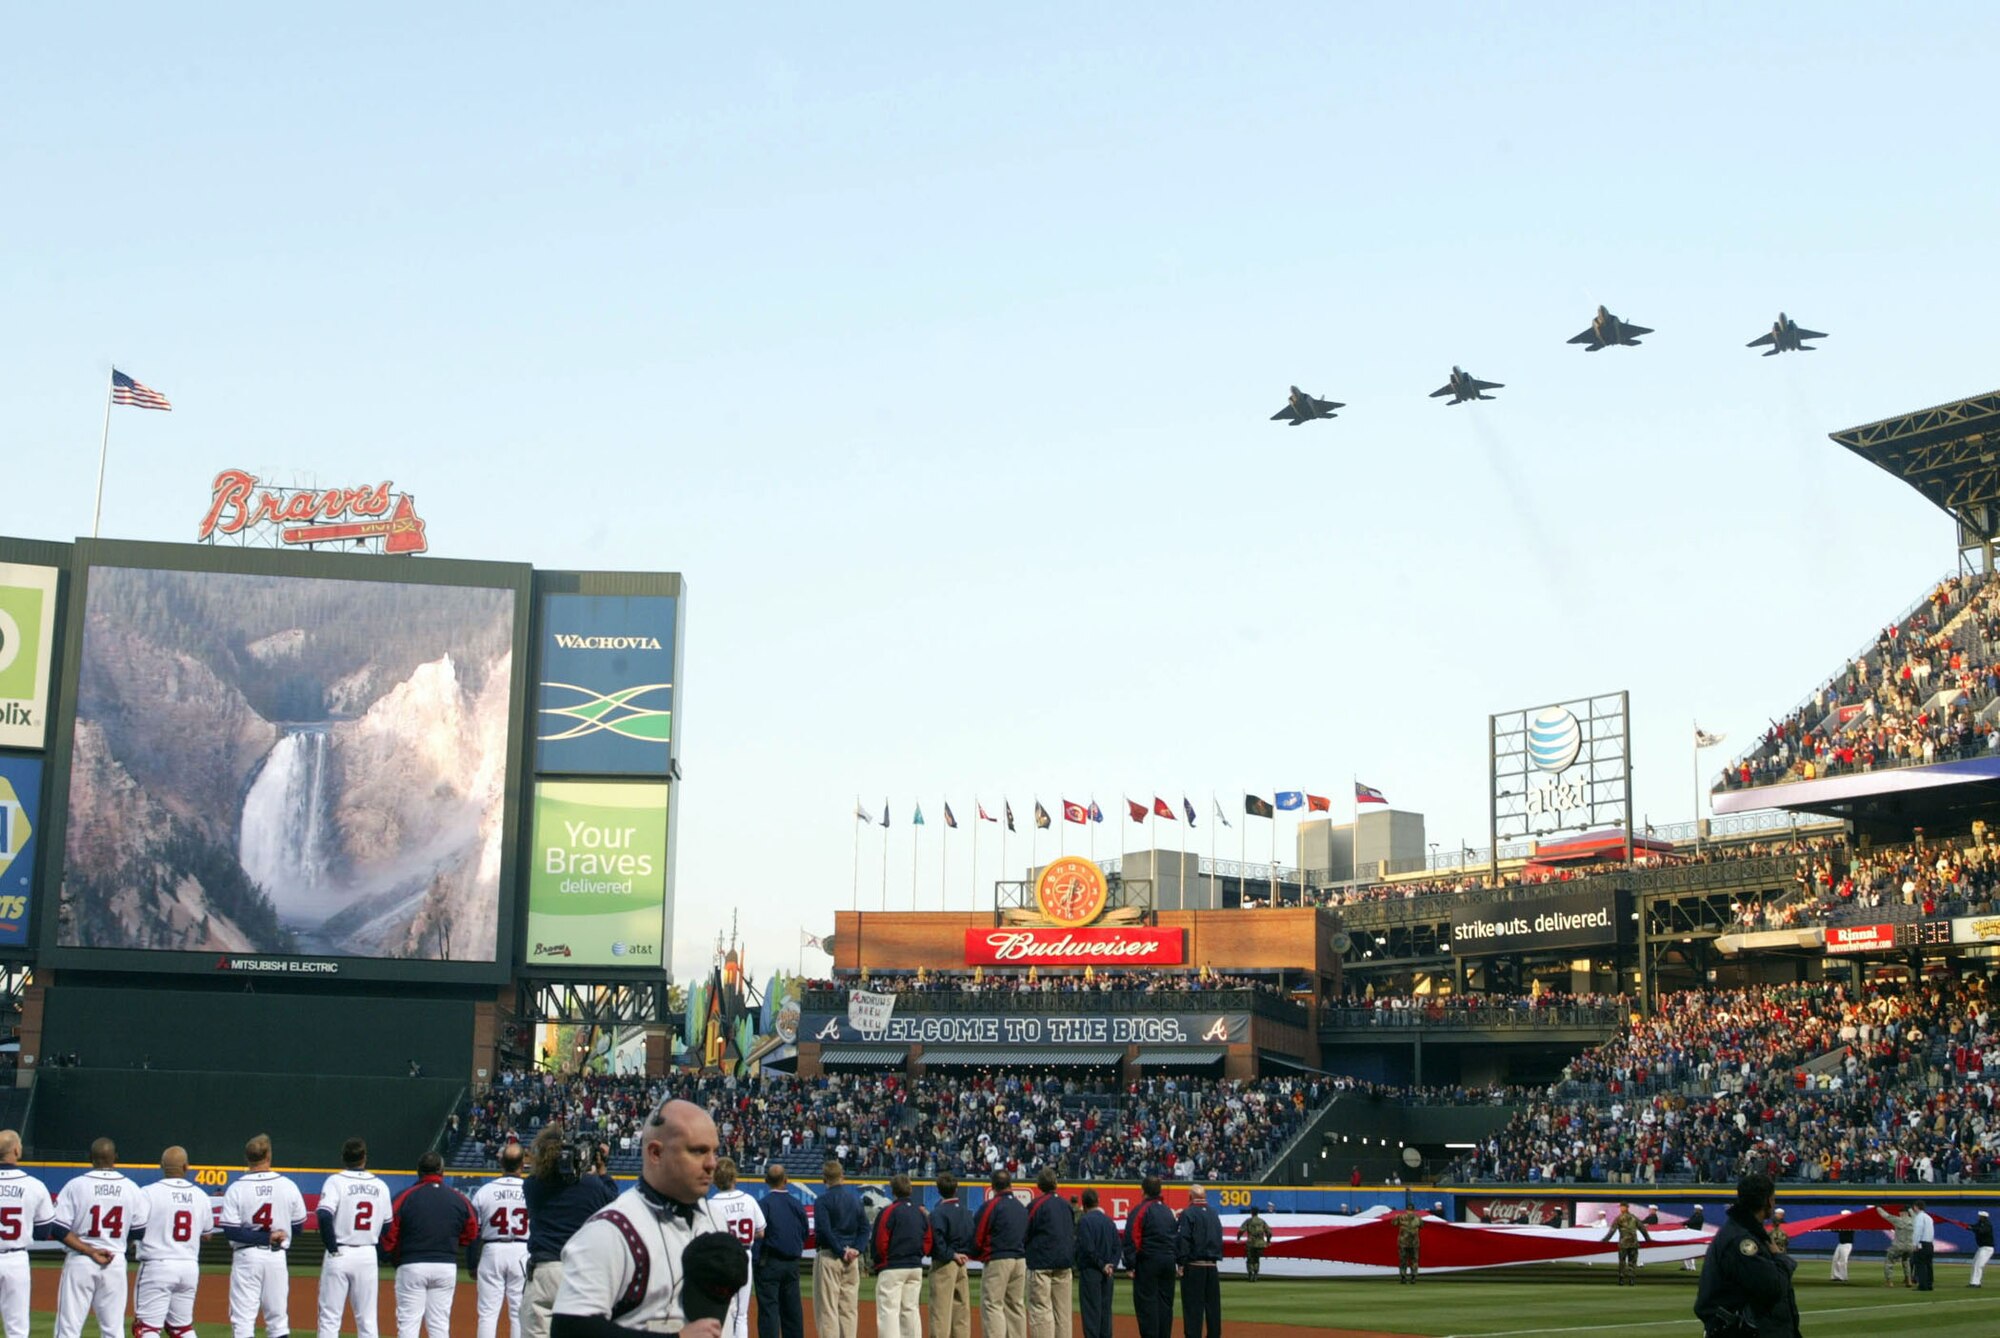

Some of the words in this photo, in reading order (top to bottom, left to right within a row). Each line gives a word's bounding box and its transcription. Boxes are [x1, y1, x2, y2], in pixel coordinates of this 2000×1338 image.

[198, 468, 393, 541] Braves
[554, 633, 663, 650] WACHOVIA
[1525, 774, 1589, 814] at&t
[564, 820, 637, 848] Your
[546, 847, 653, 876] Braves
[560, 877, 632, 894] delivered
[0, 895, 27, 919] TS
[1535, 907, 1611, 933] delivered.
[629, 943, 653, 955] at&t
[986, 932, 1159, 960] Budweiser
[231, 960, 287, 971] MITSUBISHI
[289, 961, 338, 973] ELECTRIC
[1005, 1018, 1041, 1042] TO
[1047, 1018, 1107, 1042] THE
[1113, 1018, 1187, 1042] BIGS.
[195, 1170, 228, 1185] 400
[95, 1184, 122, 1197] AYBAR
[172, 1192, 193, 1204] PENA
[347, 1184, 380, 1198] JOHNSON
[1219, 1190, 1251, 1206] 390
[88, 1205, 123, 1238] 14
[173, 1210, 192, 1242] 8
[252, 1203, 273, 1232] 4
[354, 1202, 373, 1230] 2
[489, 1207, 529, 1236] 43
